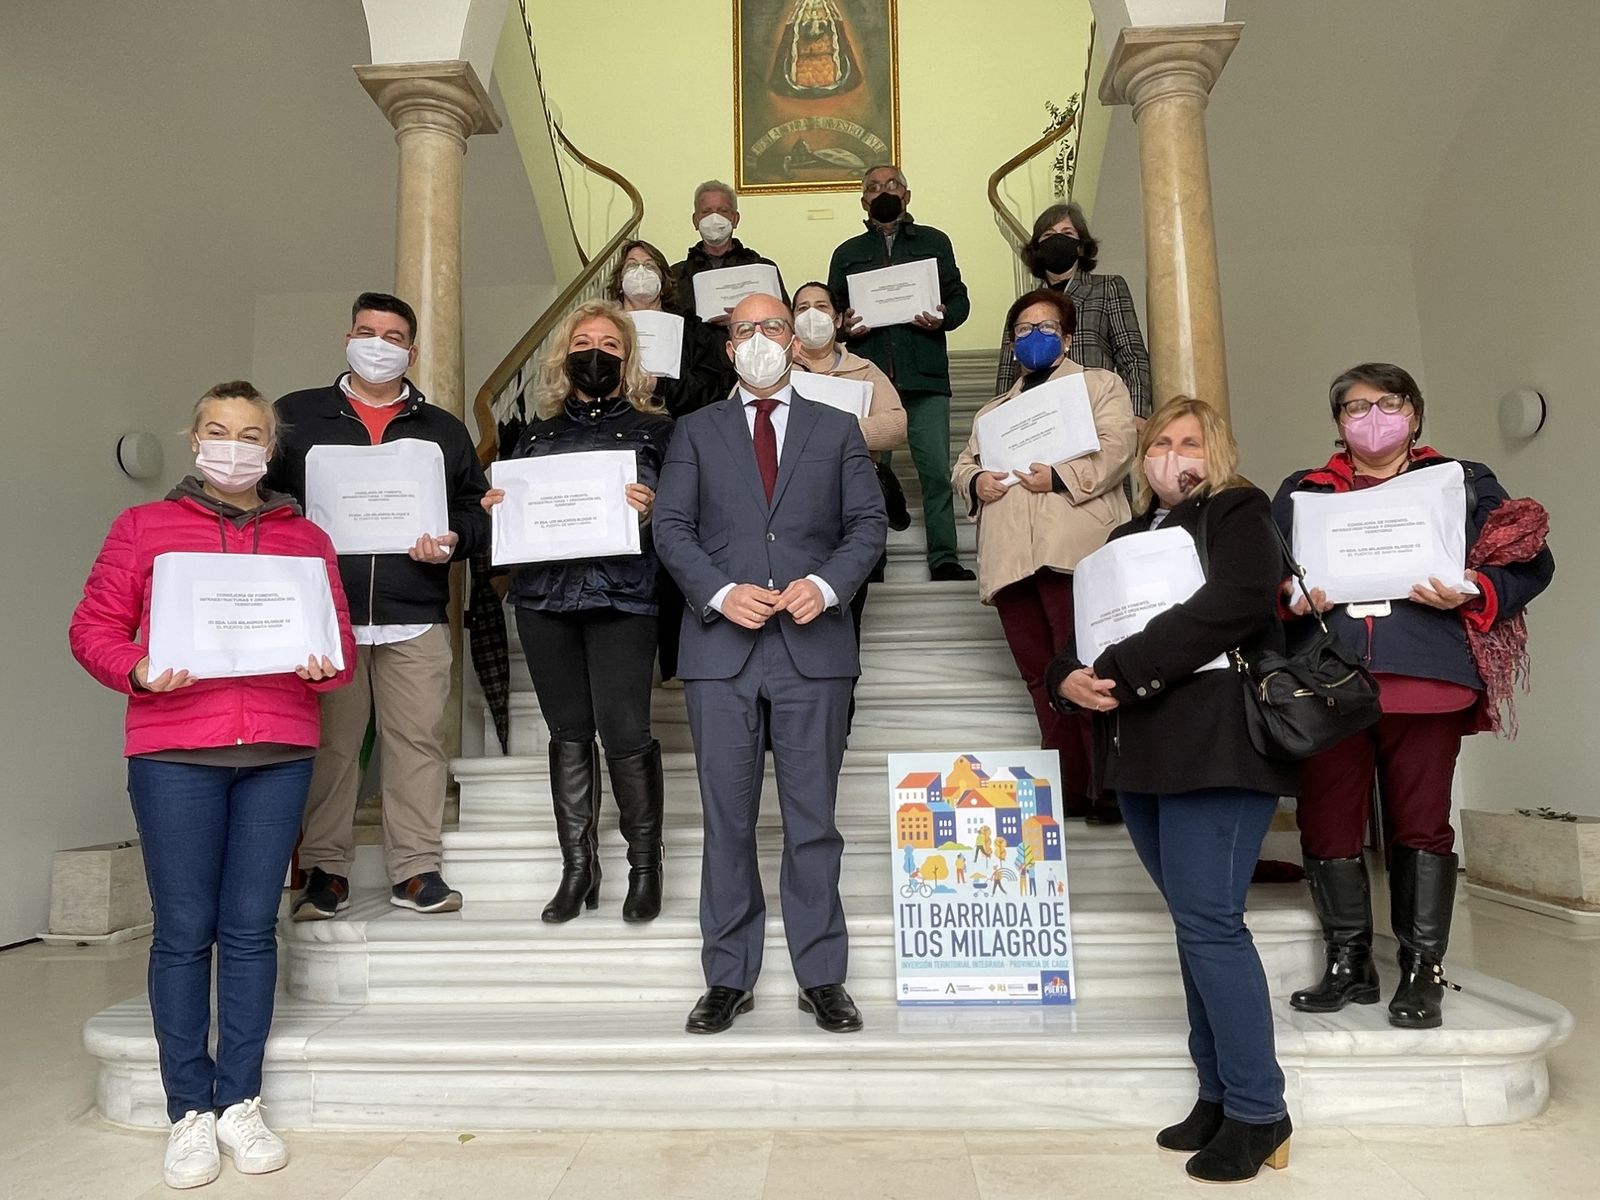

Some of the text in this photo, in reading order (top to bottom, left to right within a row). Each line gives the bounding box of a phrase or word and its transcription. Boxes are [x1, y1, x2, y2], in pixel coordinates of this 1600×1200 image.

[900, 902, 1065, 928] ITI BARRIADA DE
[901, 929, 1067, 957] LOS MILAGROS
[934, 960, 970, 969] TERRITORIAL
[972, 960, 1005, 968] INTEGRADA
[1009, 960, 1041, 968] PROVINCIA
[1043, 959, 1050, 967] DE
